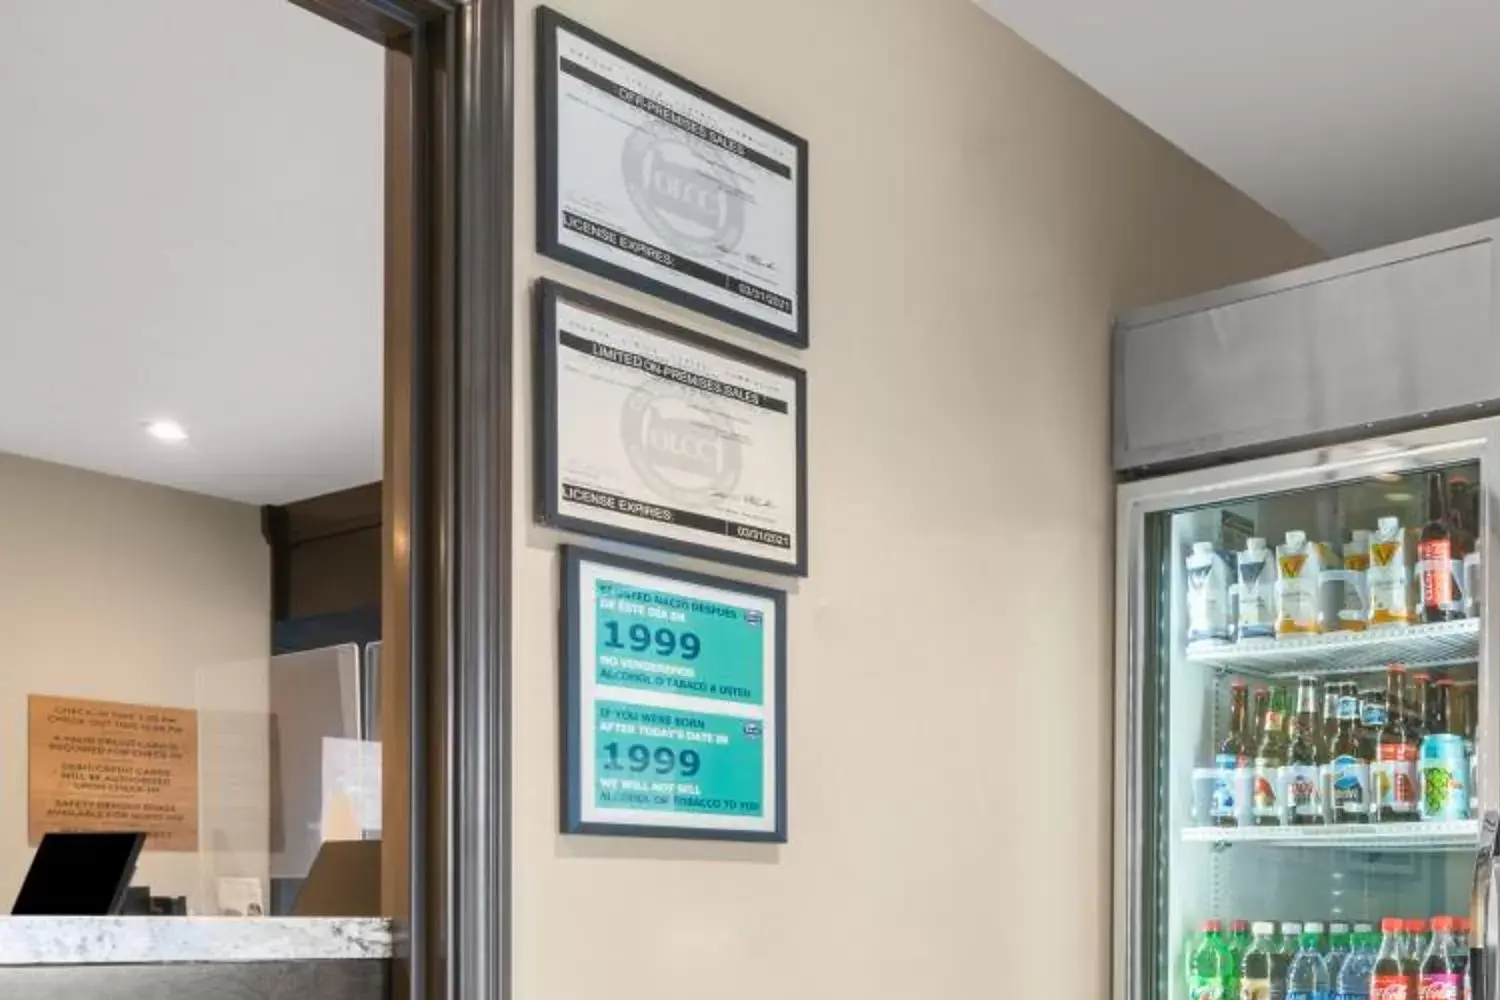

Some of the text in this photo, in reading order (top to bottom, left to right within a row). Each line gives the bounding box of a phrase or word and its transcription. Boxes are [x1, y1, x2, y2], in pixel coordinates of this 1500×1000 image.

[562, 213, 618, 246] LICENSE
[592, 342, 643, 368] LIMITED
[562, 486, 616, 509] LICENSE
[604, 619, 702, 661] 1999
[600, 720, 637, 735] AFTER
[615, 710, 640, 722] YOU
[641, 712, 674, 727] WERE
[675, 716, 706, 731] BORN
[603, 741, 702, 778] 1999
